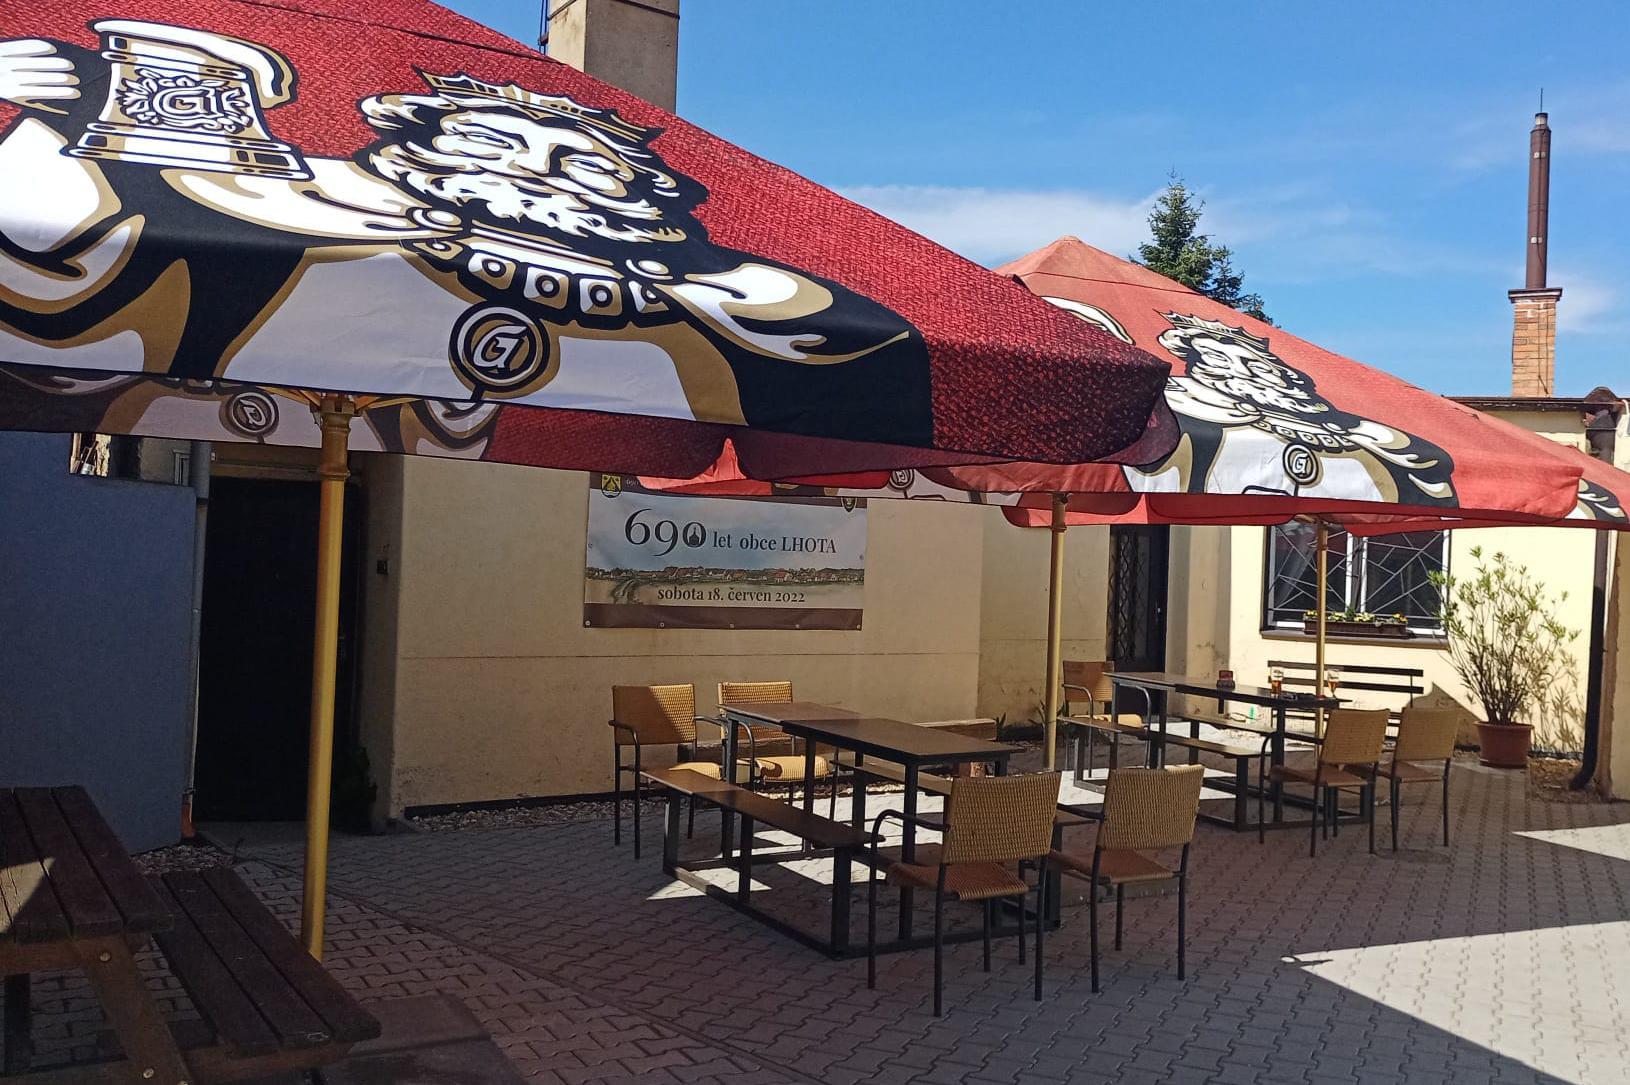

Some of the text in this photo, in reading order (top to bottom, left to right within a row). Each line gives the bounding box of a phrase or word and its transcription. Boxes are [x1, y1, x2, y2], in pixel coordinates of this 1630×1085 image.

[624, 508, 837, 557] 690 let obce LHOTA
[657, 586, 806, 603] sobota 18. červen 2022
